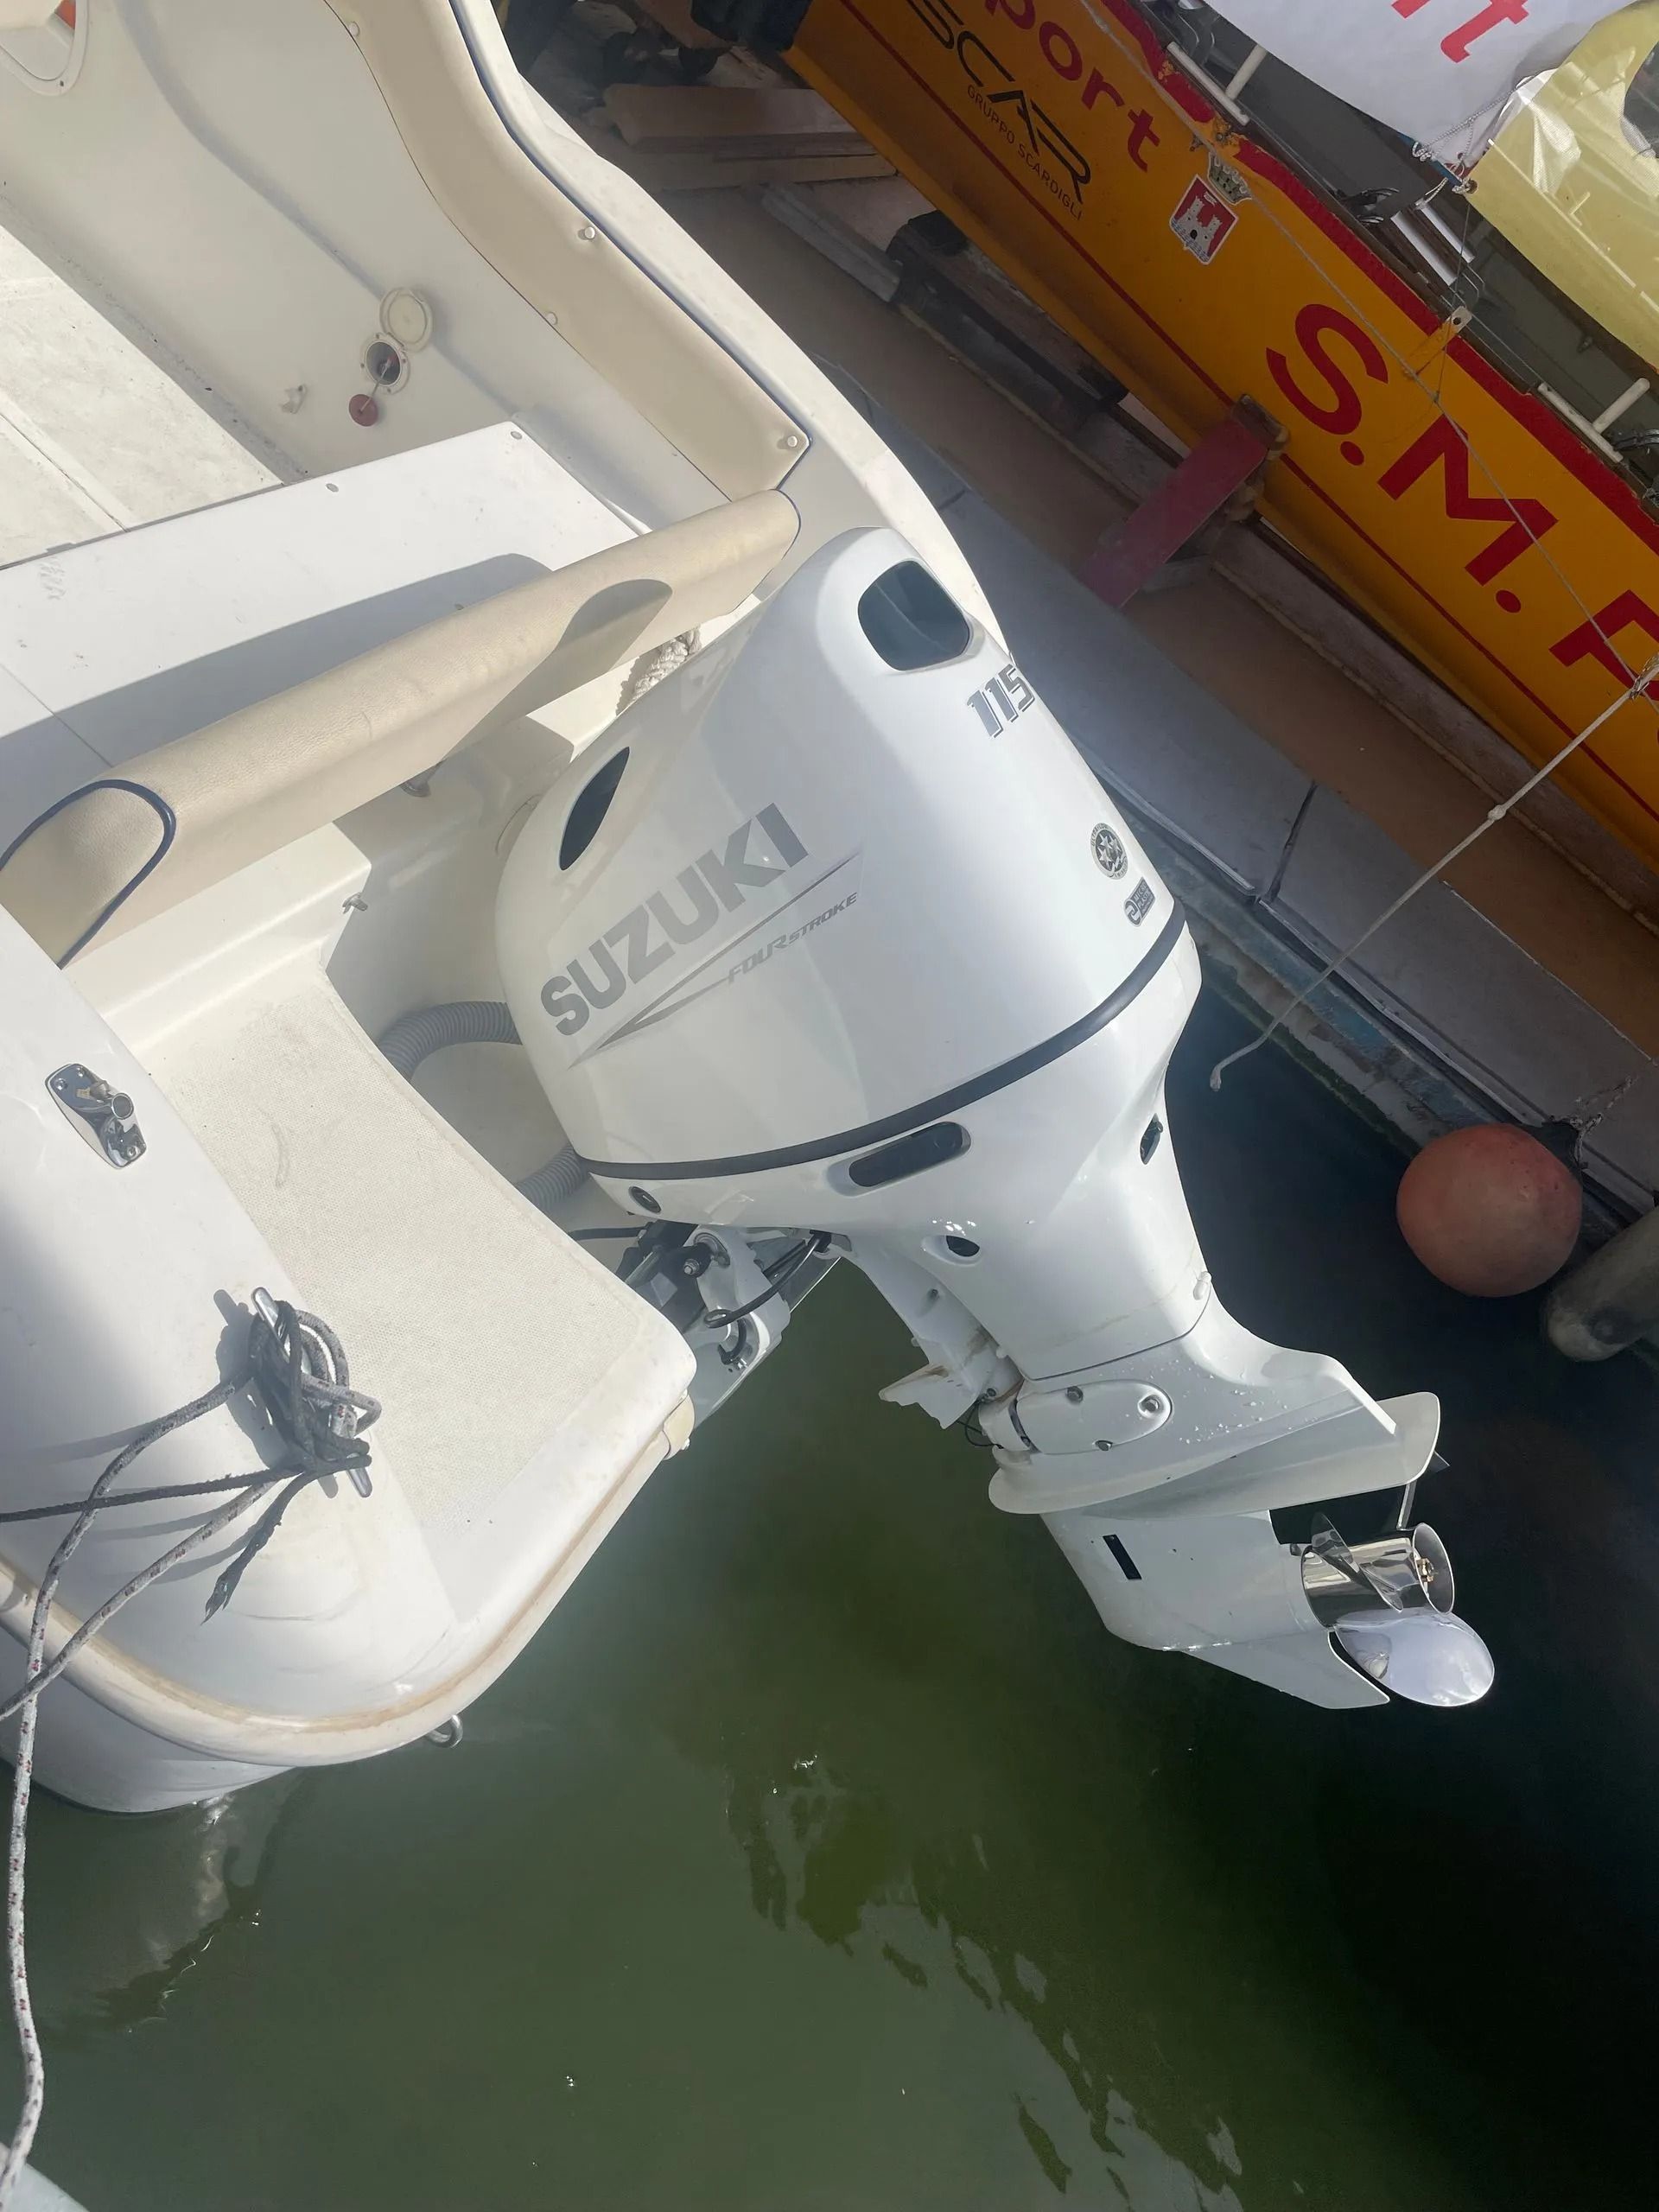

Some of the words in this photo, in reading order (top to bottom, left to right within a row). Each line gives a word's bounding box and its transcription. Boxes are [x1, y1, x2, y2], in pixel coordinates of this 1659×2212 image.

[967, 85, 1015, 145] GRUPPO
[1017, 143, 1083, 221] SCARDIGLI
[966, 664, 1035, 739] 115
[540, 802, 809, 1036] SUZUKI
[728, 934, 788, 985] FOUR
[788, 892, 858, 945] STROKE
